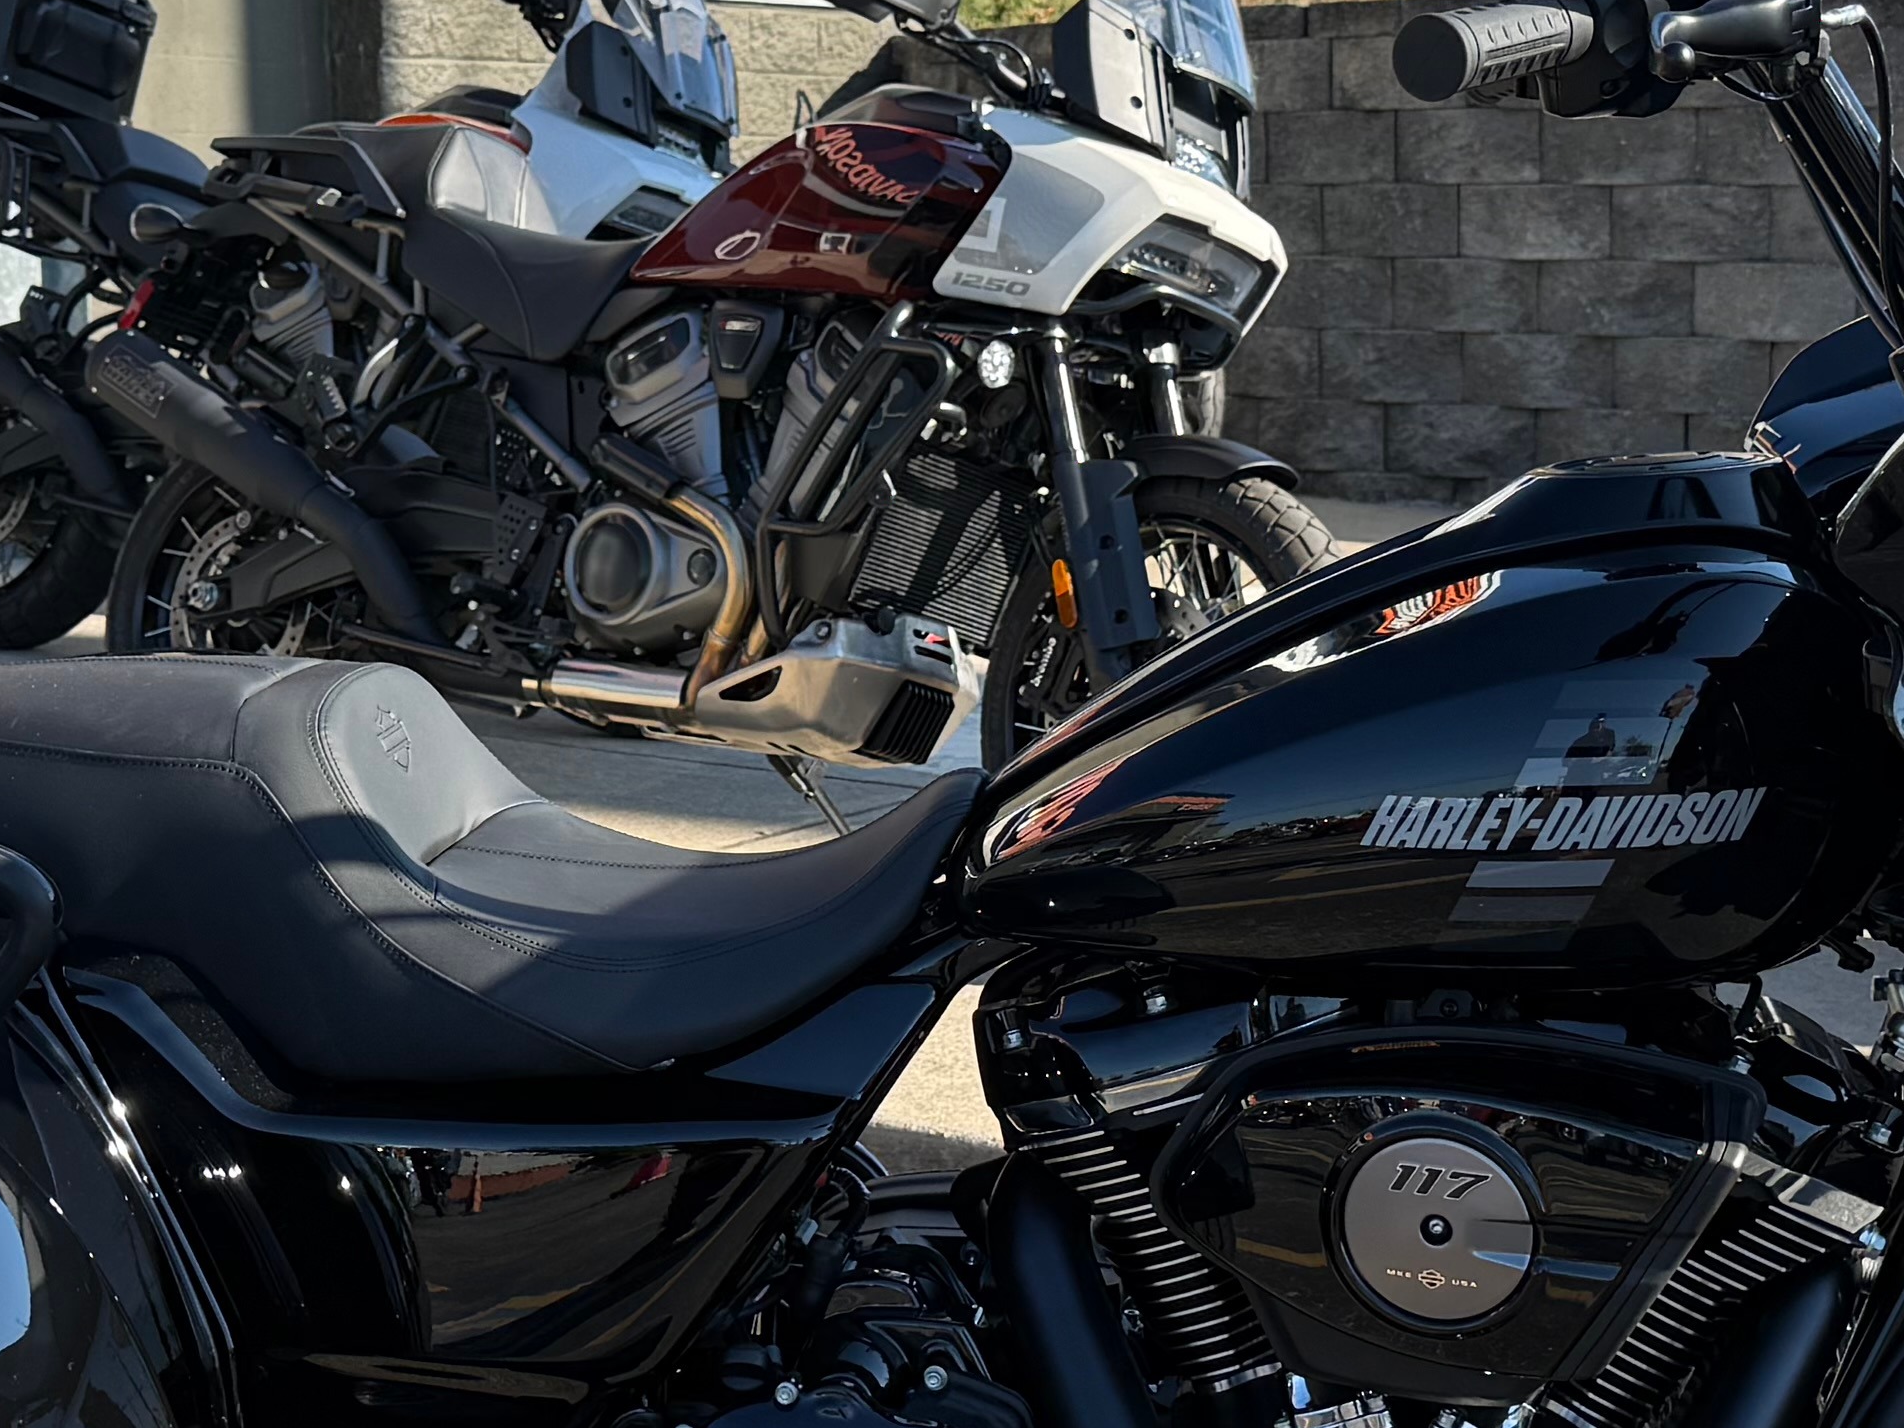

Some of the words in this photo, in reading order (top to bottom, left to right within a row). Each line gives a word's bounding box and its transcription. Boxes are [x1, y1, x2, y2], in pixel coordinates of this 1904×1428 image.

[951, 272, 1031, 296] 1250
[1359, 785, 1768, 852] HARLEY-DAVIDSON
[1388, 1162, 1492, 1202] 117
[1386, 1268, 1413, 1280] MKE
[1451, 1278, 1479, 1290] USA
